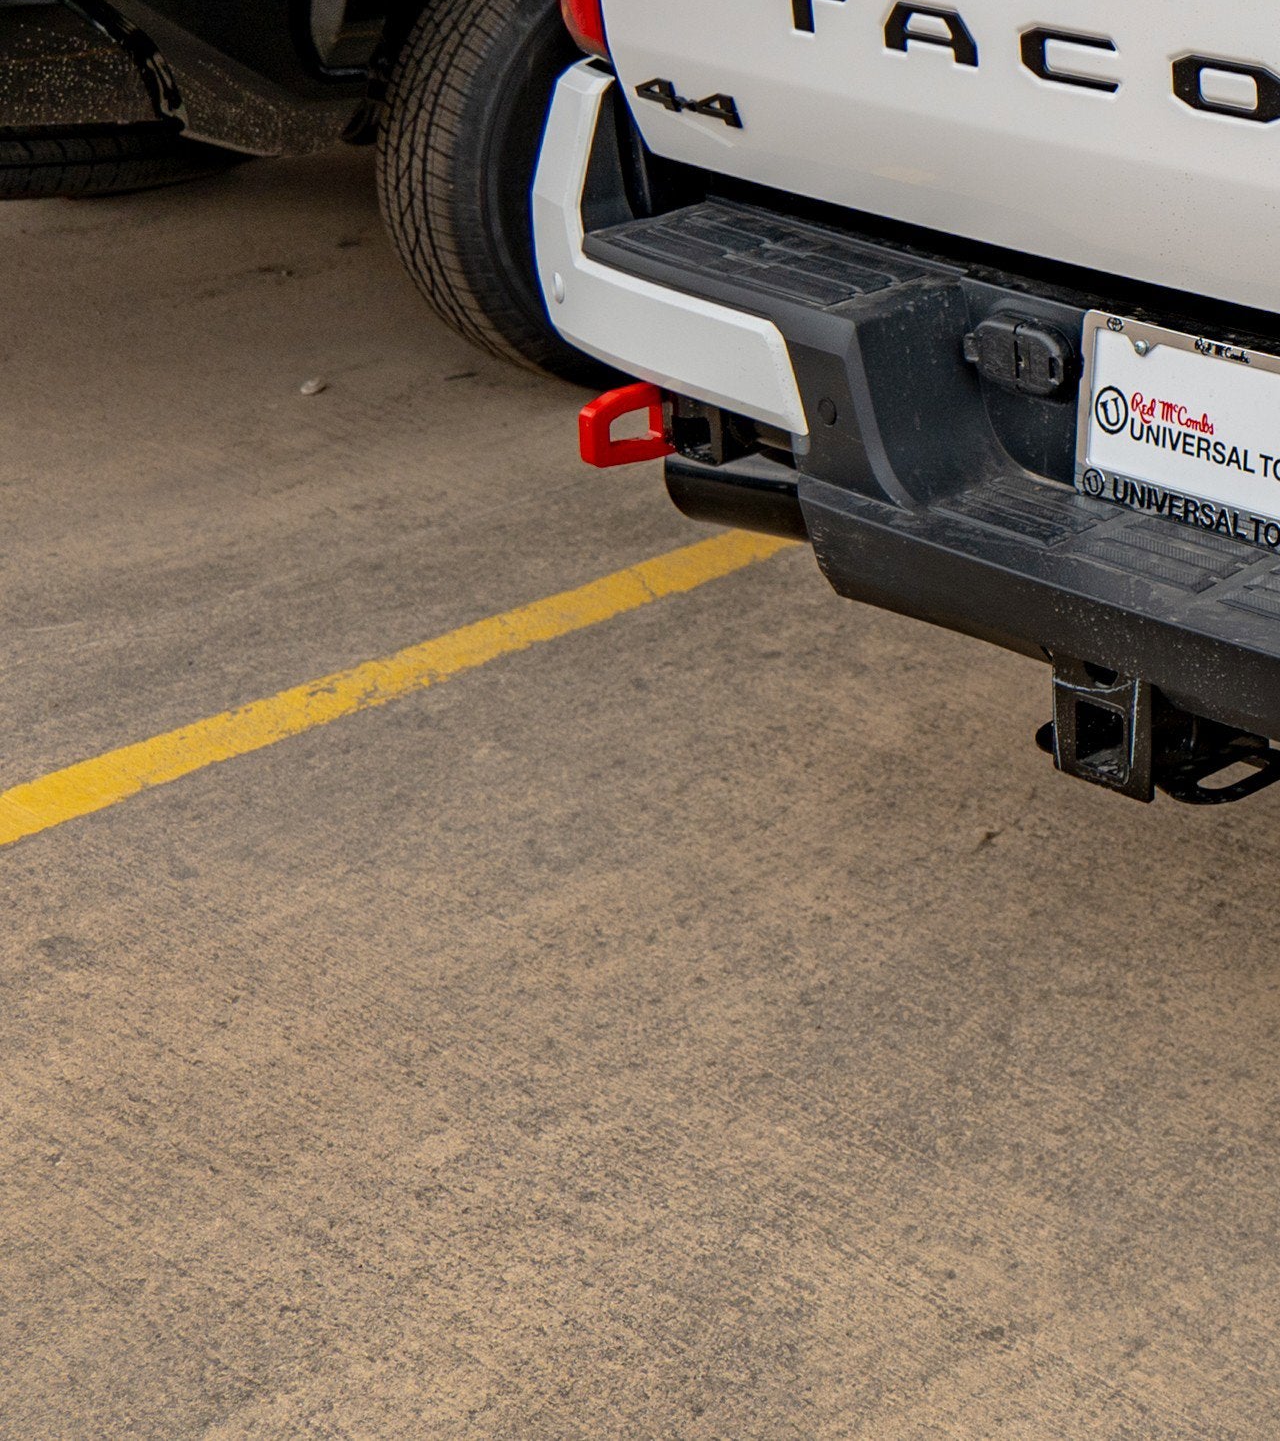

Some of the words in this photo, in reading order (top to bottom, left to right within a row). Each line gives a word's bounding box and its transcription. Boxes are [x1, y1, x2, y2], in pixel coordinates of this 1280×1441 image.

[1131, 392, 1156, 424] Red
[1158, 400, 1215, 435] McCombs
[1130, 418, 1255, 473] UNIVERSAL
[1112, 477, 1248, 539] UNIVERSAL
